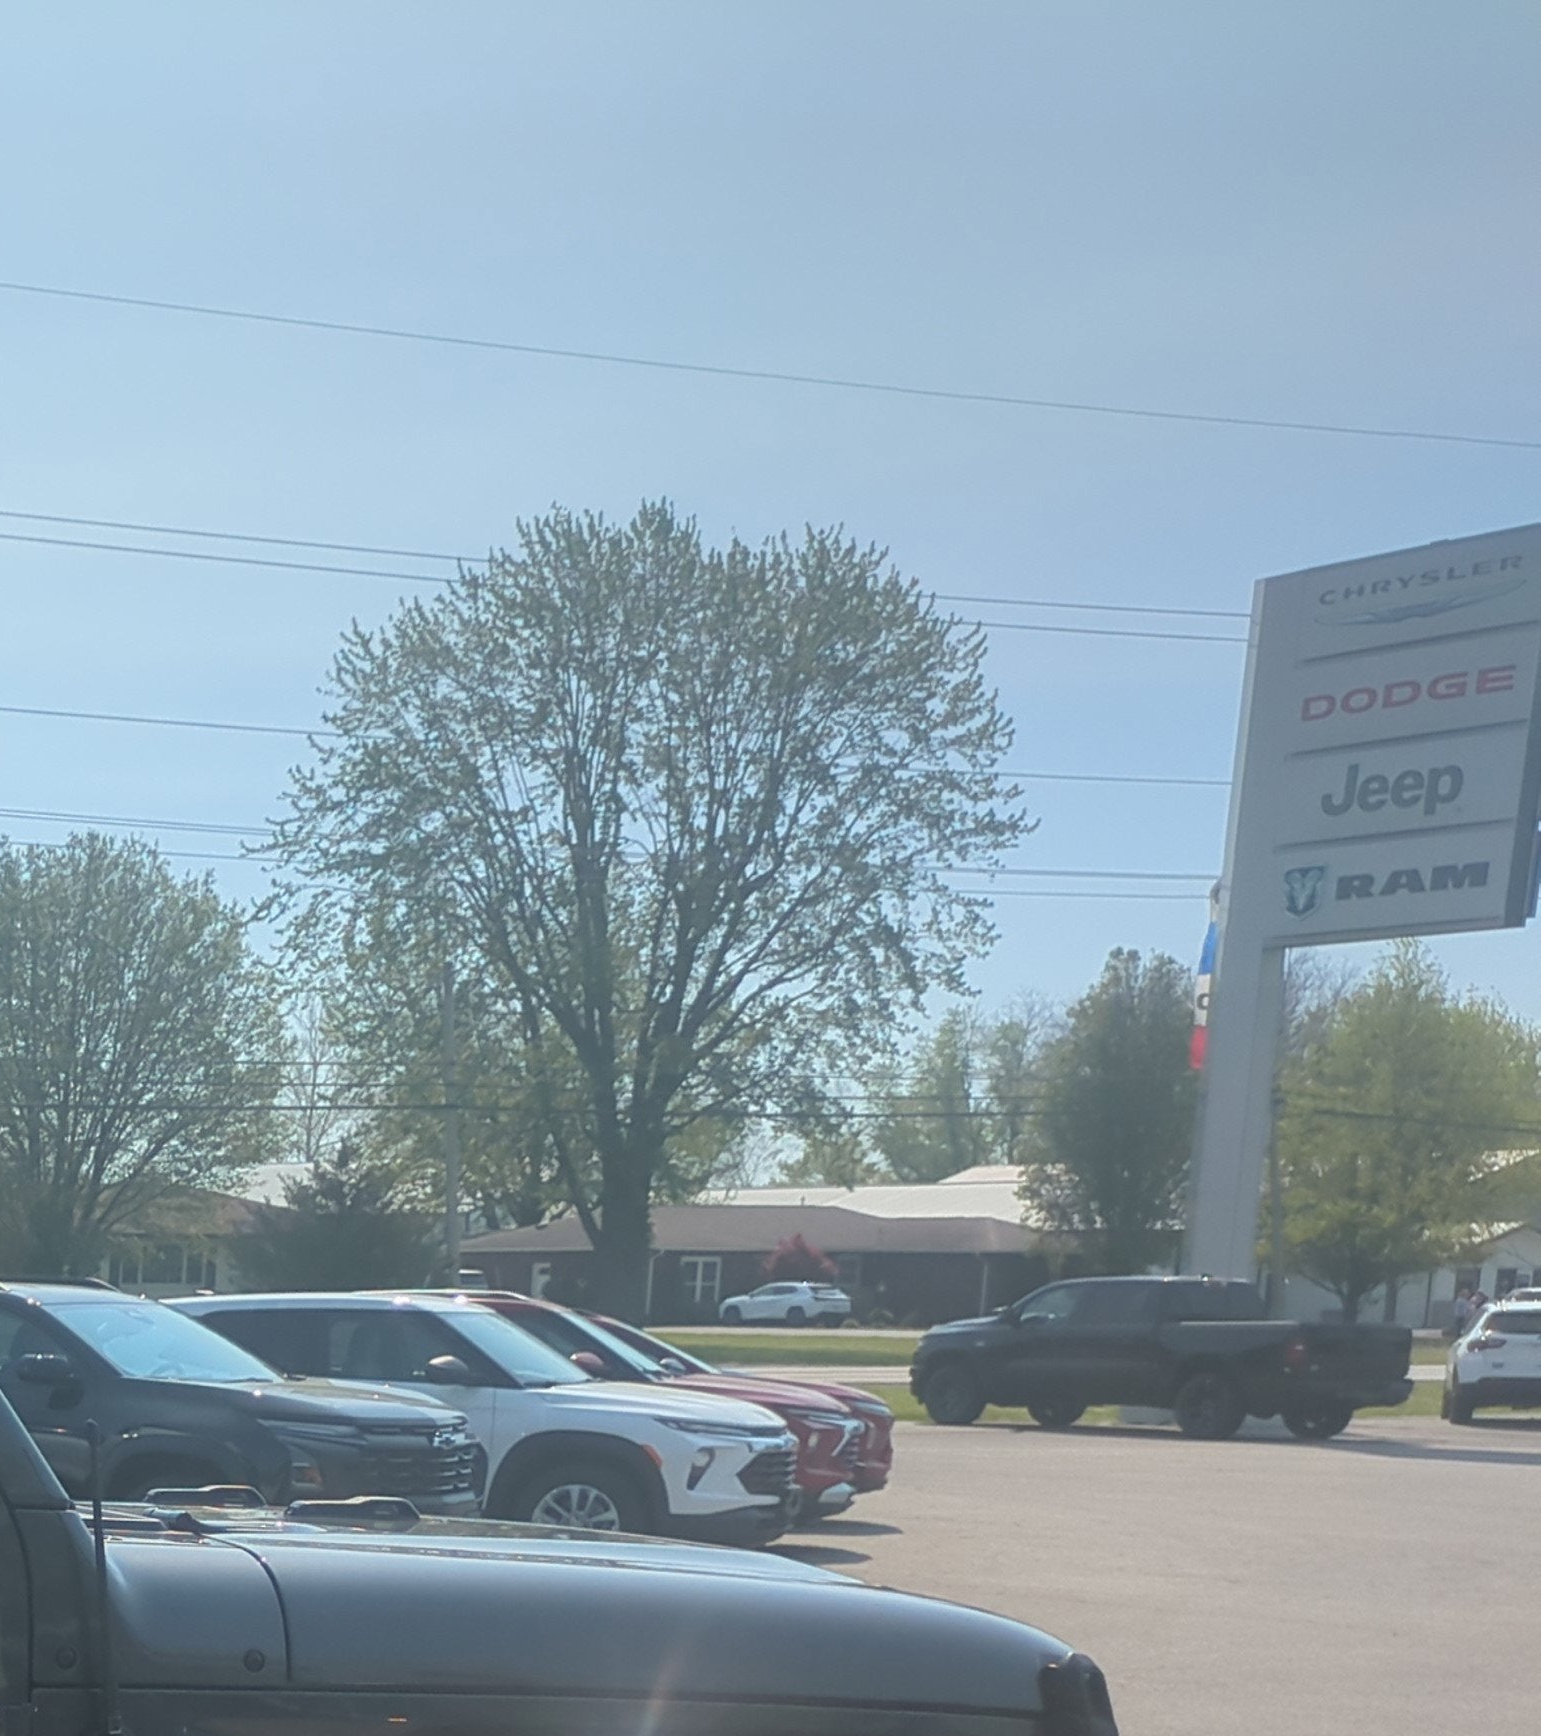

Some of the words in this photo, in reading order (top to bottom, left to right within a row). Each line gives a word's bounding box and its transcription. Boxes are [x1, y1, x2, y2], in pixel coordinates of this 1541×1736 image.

[1318, 554, 1524, 606] CHRYSLER
[1300, 664, 1517, 722] DODGE
[1320, 763, 1464, 816] Jeep
[1334, 861, 1490, 901] RAM
